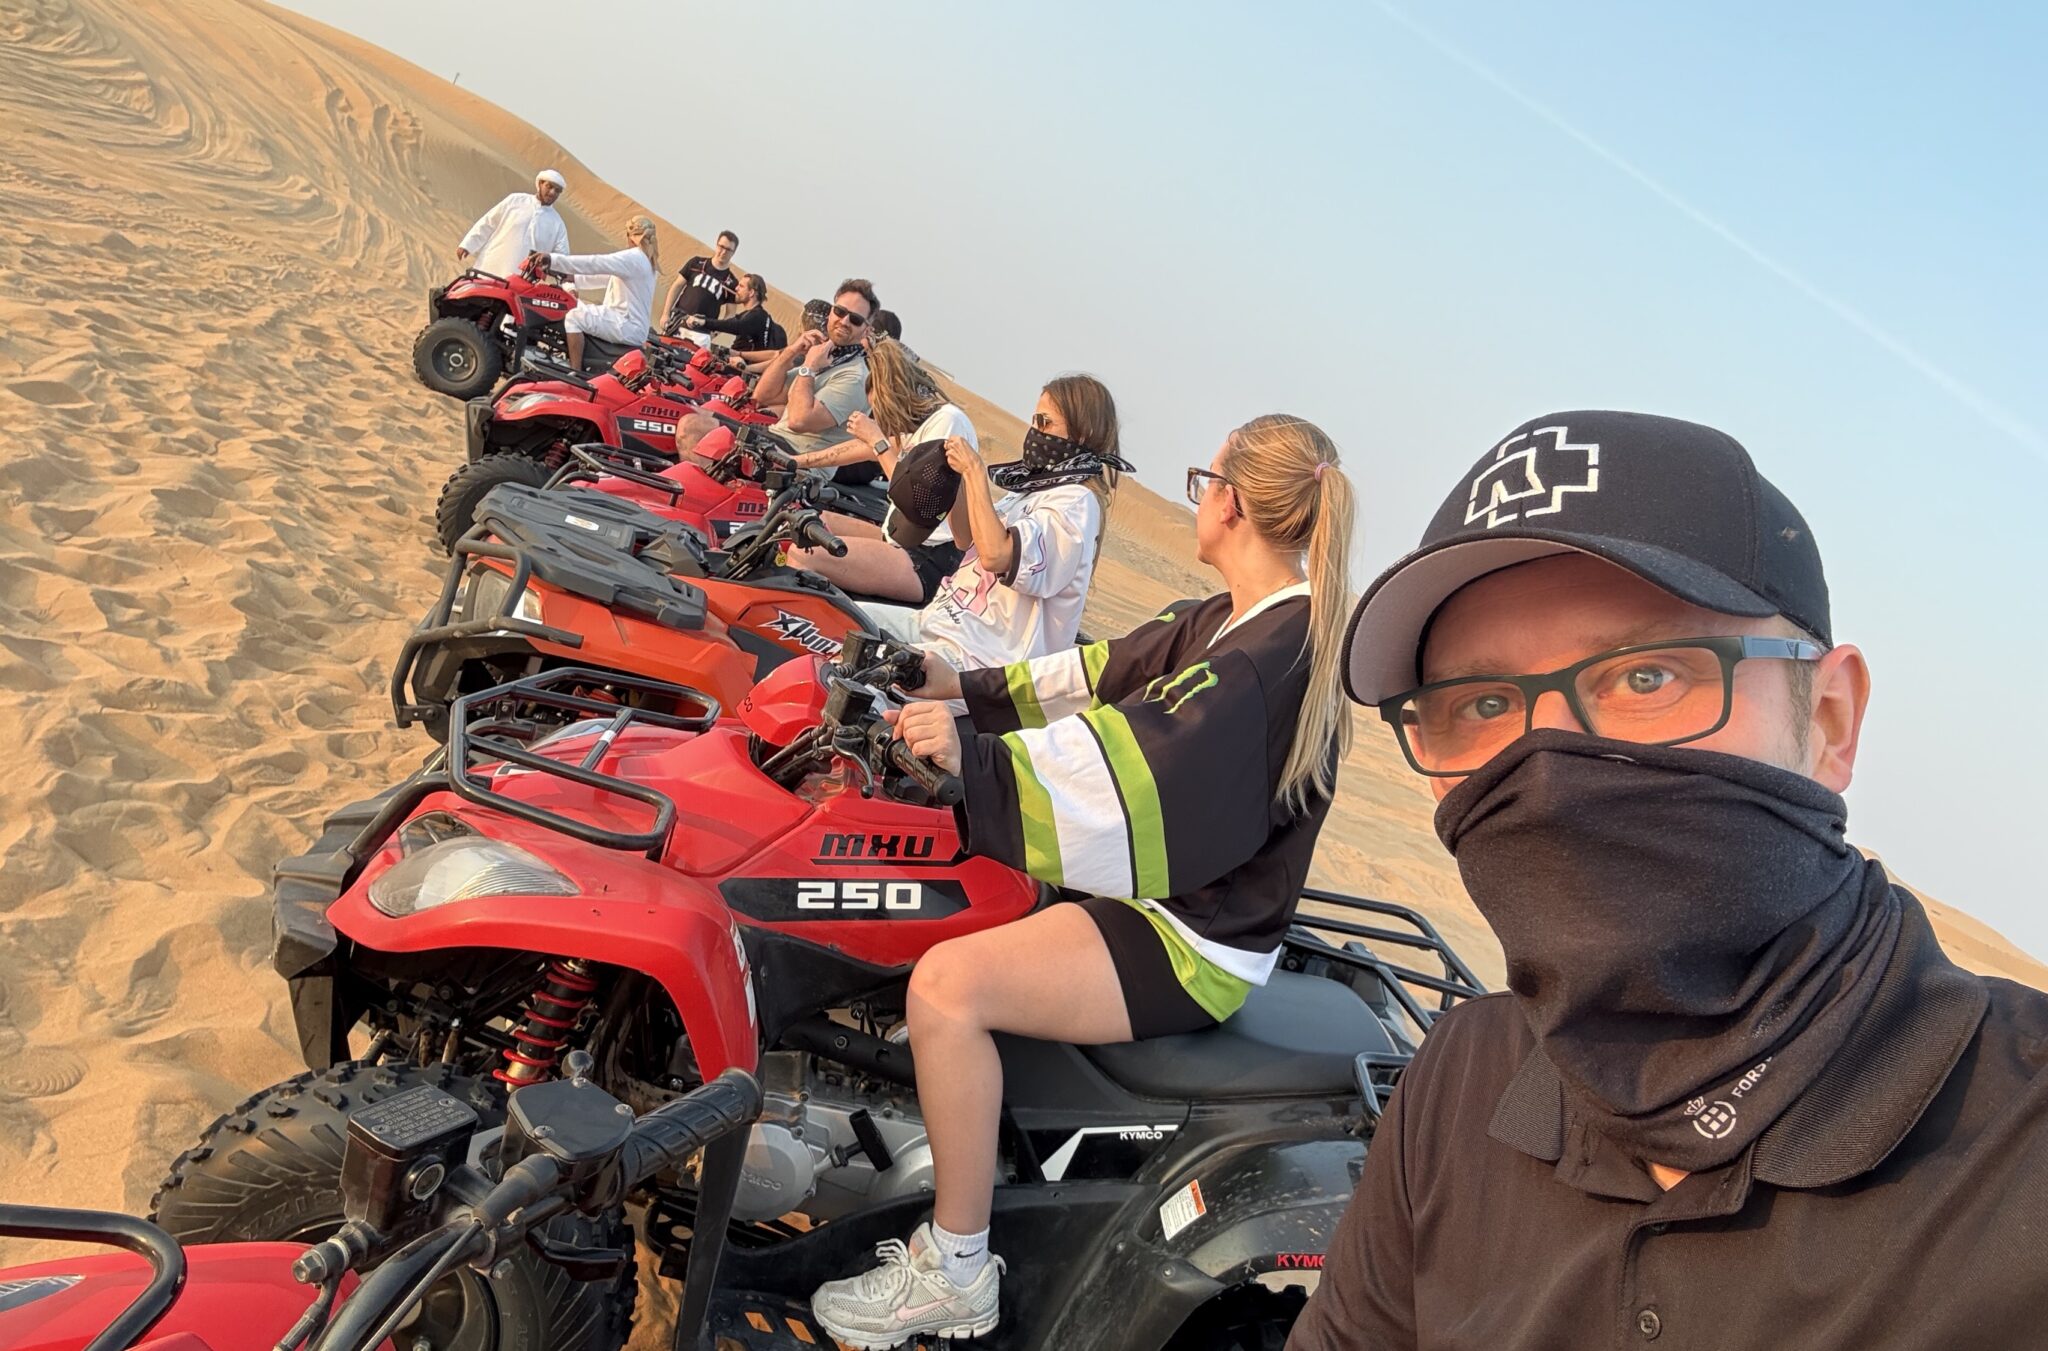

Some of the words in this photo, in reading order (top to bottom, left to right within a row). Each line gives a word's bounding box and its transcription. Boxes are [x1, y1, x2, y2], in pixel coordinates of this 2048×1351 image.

[532, 298, 559, 309] 250
[633, 419, 677, 435] 250
[818, 833, 935, 858] MXU
[797, 881, 922, 910] 250
[1119, 1131, 1163, 1140] KYMCO
